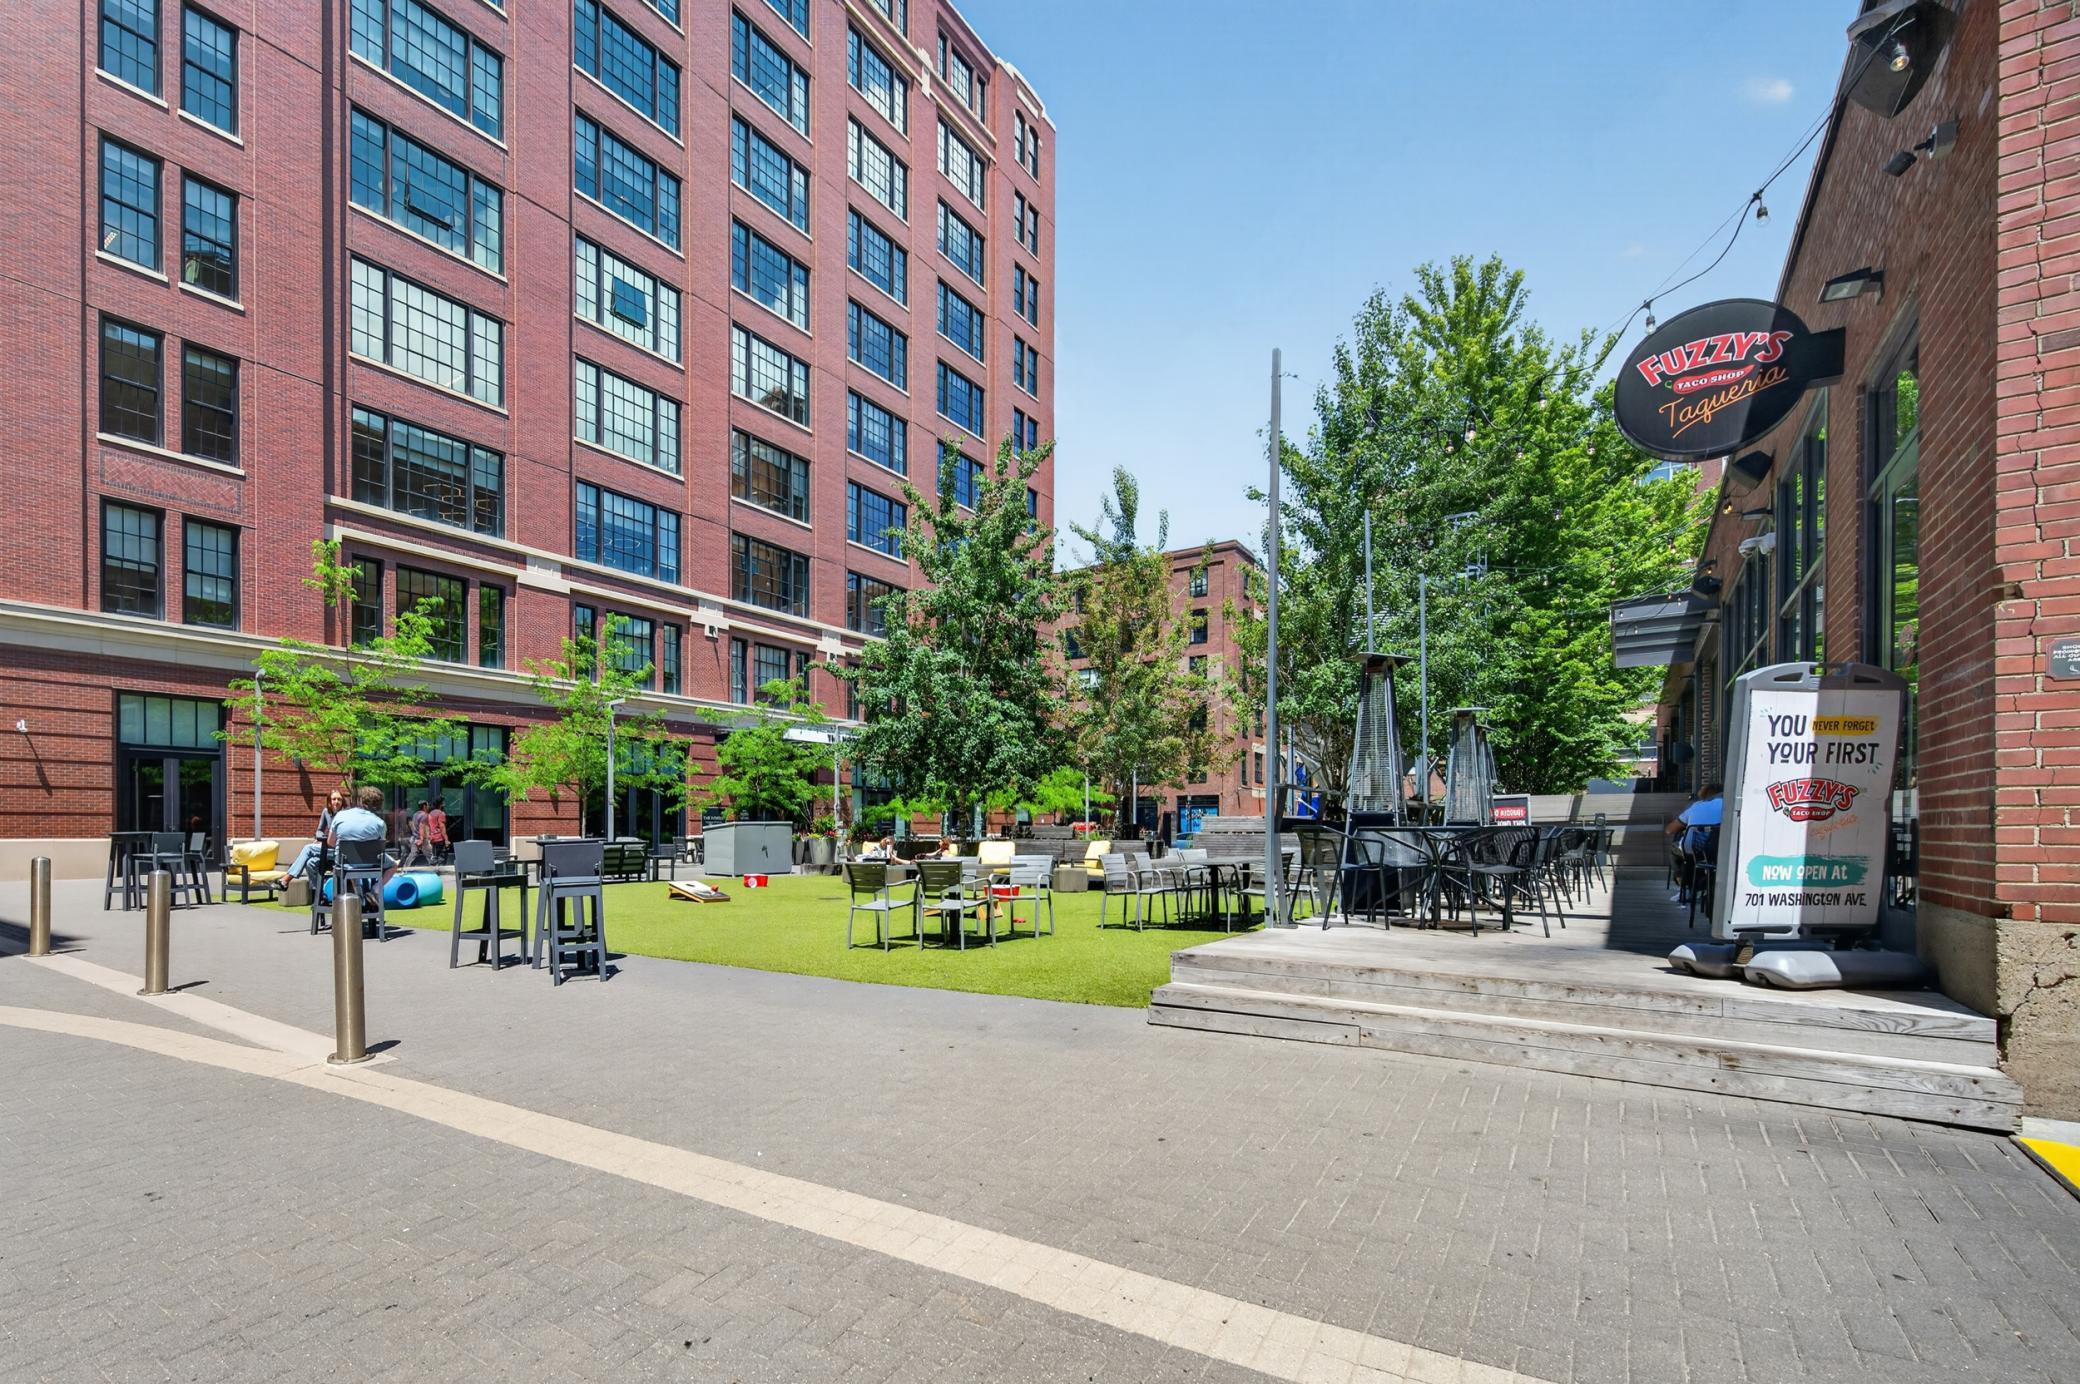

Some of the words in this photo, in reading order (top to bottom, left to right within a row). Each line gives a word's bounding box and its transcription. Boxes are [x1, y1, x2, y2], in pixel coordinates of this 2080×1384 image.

[1636, 330, 1794, 387] FUZZY'S
[1677, 379, 1708, 390] TACO
[1711, 370, 1745, 384] SHOP
[1658, 366, 1787, 428] Taqueria
[1768, 714, 1807, 737] YOU
[1812, 721, 1840, 731] NEVER
[1767, 742, 1819, 764] YOUR
[1825, 742, 1880, 764] FIRST
[1766, 778, 1860, 812] FUZZY'S
[1762, 864, 1793, 880] NOW
[1796, 865, 1828, 880] OPEN
[1745, 893, 1765, 906] 701
